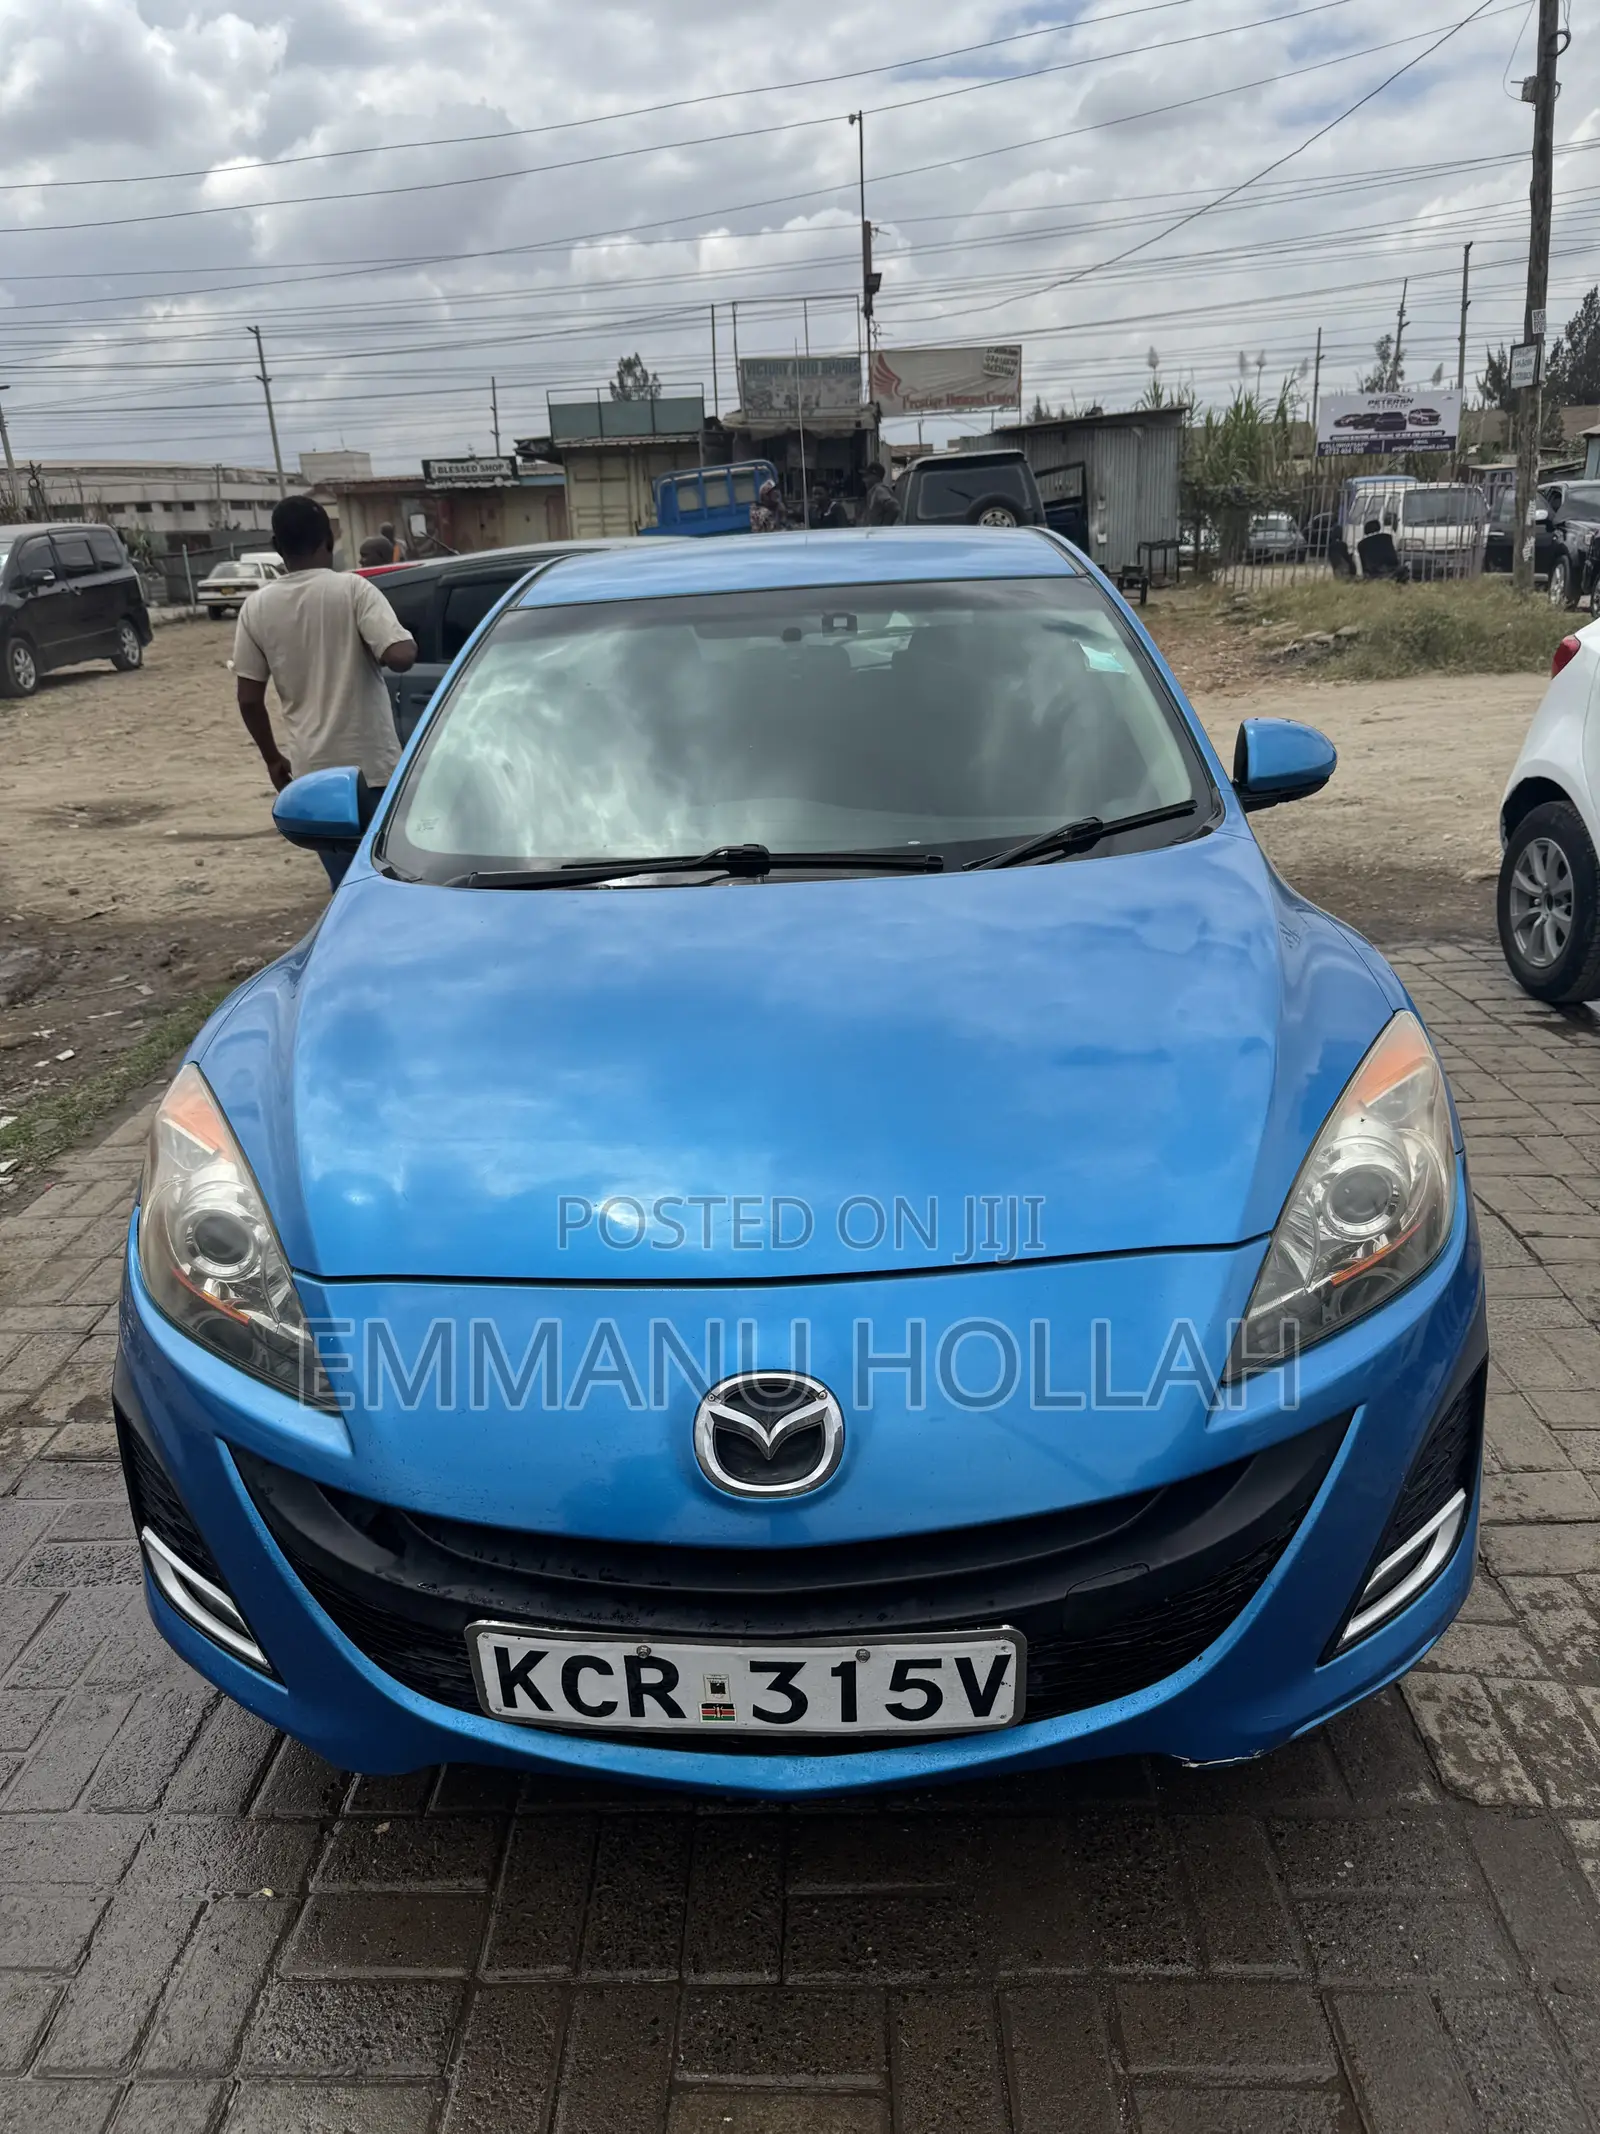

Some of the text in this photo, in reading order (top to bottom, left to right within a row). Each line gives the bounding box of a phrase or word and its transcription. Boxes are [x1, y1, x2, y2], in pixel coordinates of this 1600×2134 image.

[791, 359, 818, 376] AUTO
[437, 464, 478, 475] BLESSED
[480, 463, 505, 473] SHOP
[493, 1645, 1013, 1724] KCR 315V
